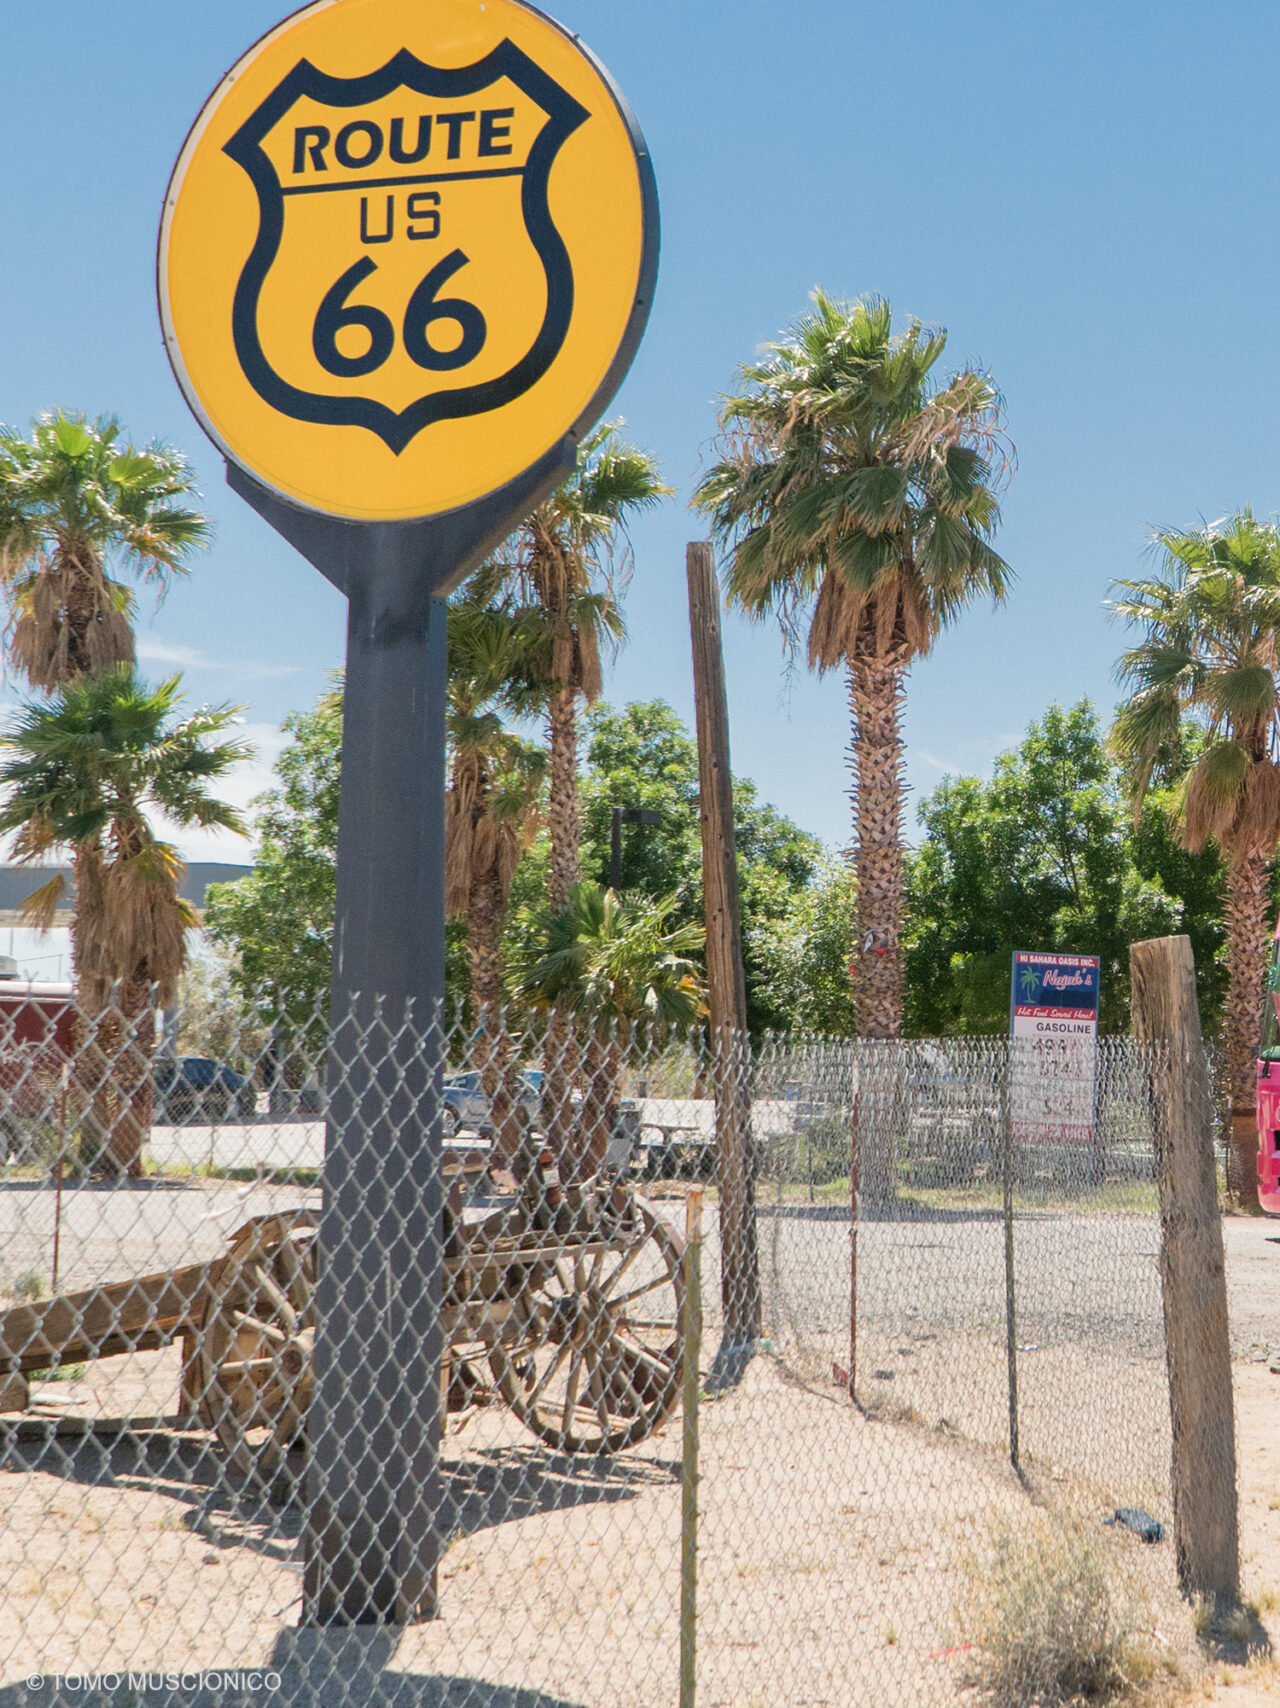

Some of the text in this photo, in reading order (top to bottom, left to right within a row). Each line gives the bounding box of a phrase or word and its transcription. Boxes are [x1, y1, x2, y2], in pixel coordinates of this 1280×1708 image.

[292, 107, 516, 174] ROUTE
[359, 191, 442, 244] US
[312, 248, 488, 378] 66
[1020, 954, 1095, 967] HI SAHARA OASIS INC.
[1033, 1008, 1048, 1017] Food
[1036, 1022, 1091, 1034] GASOLINE
